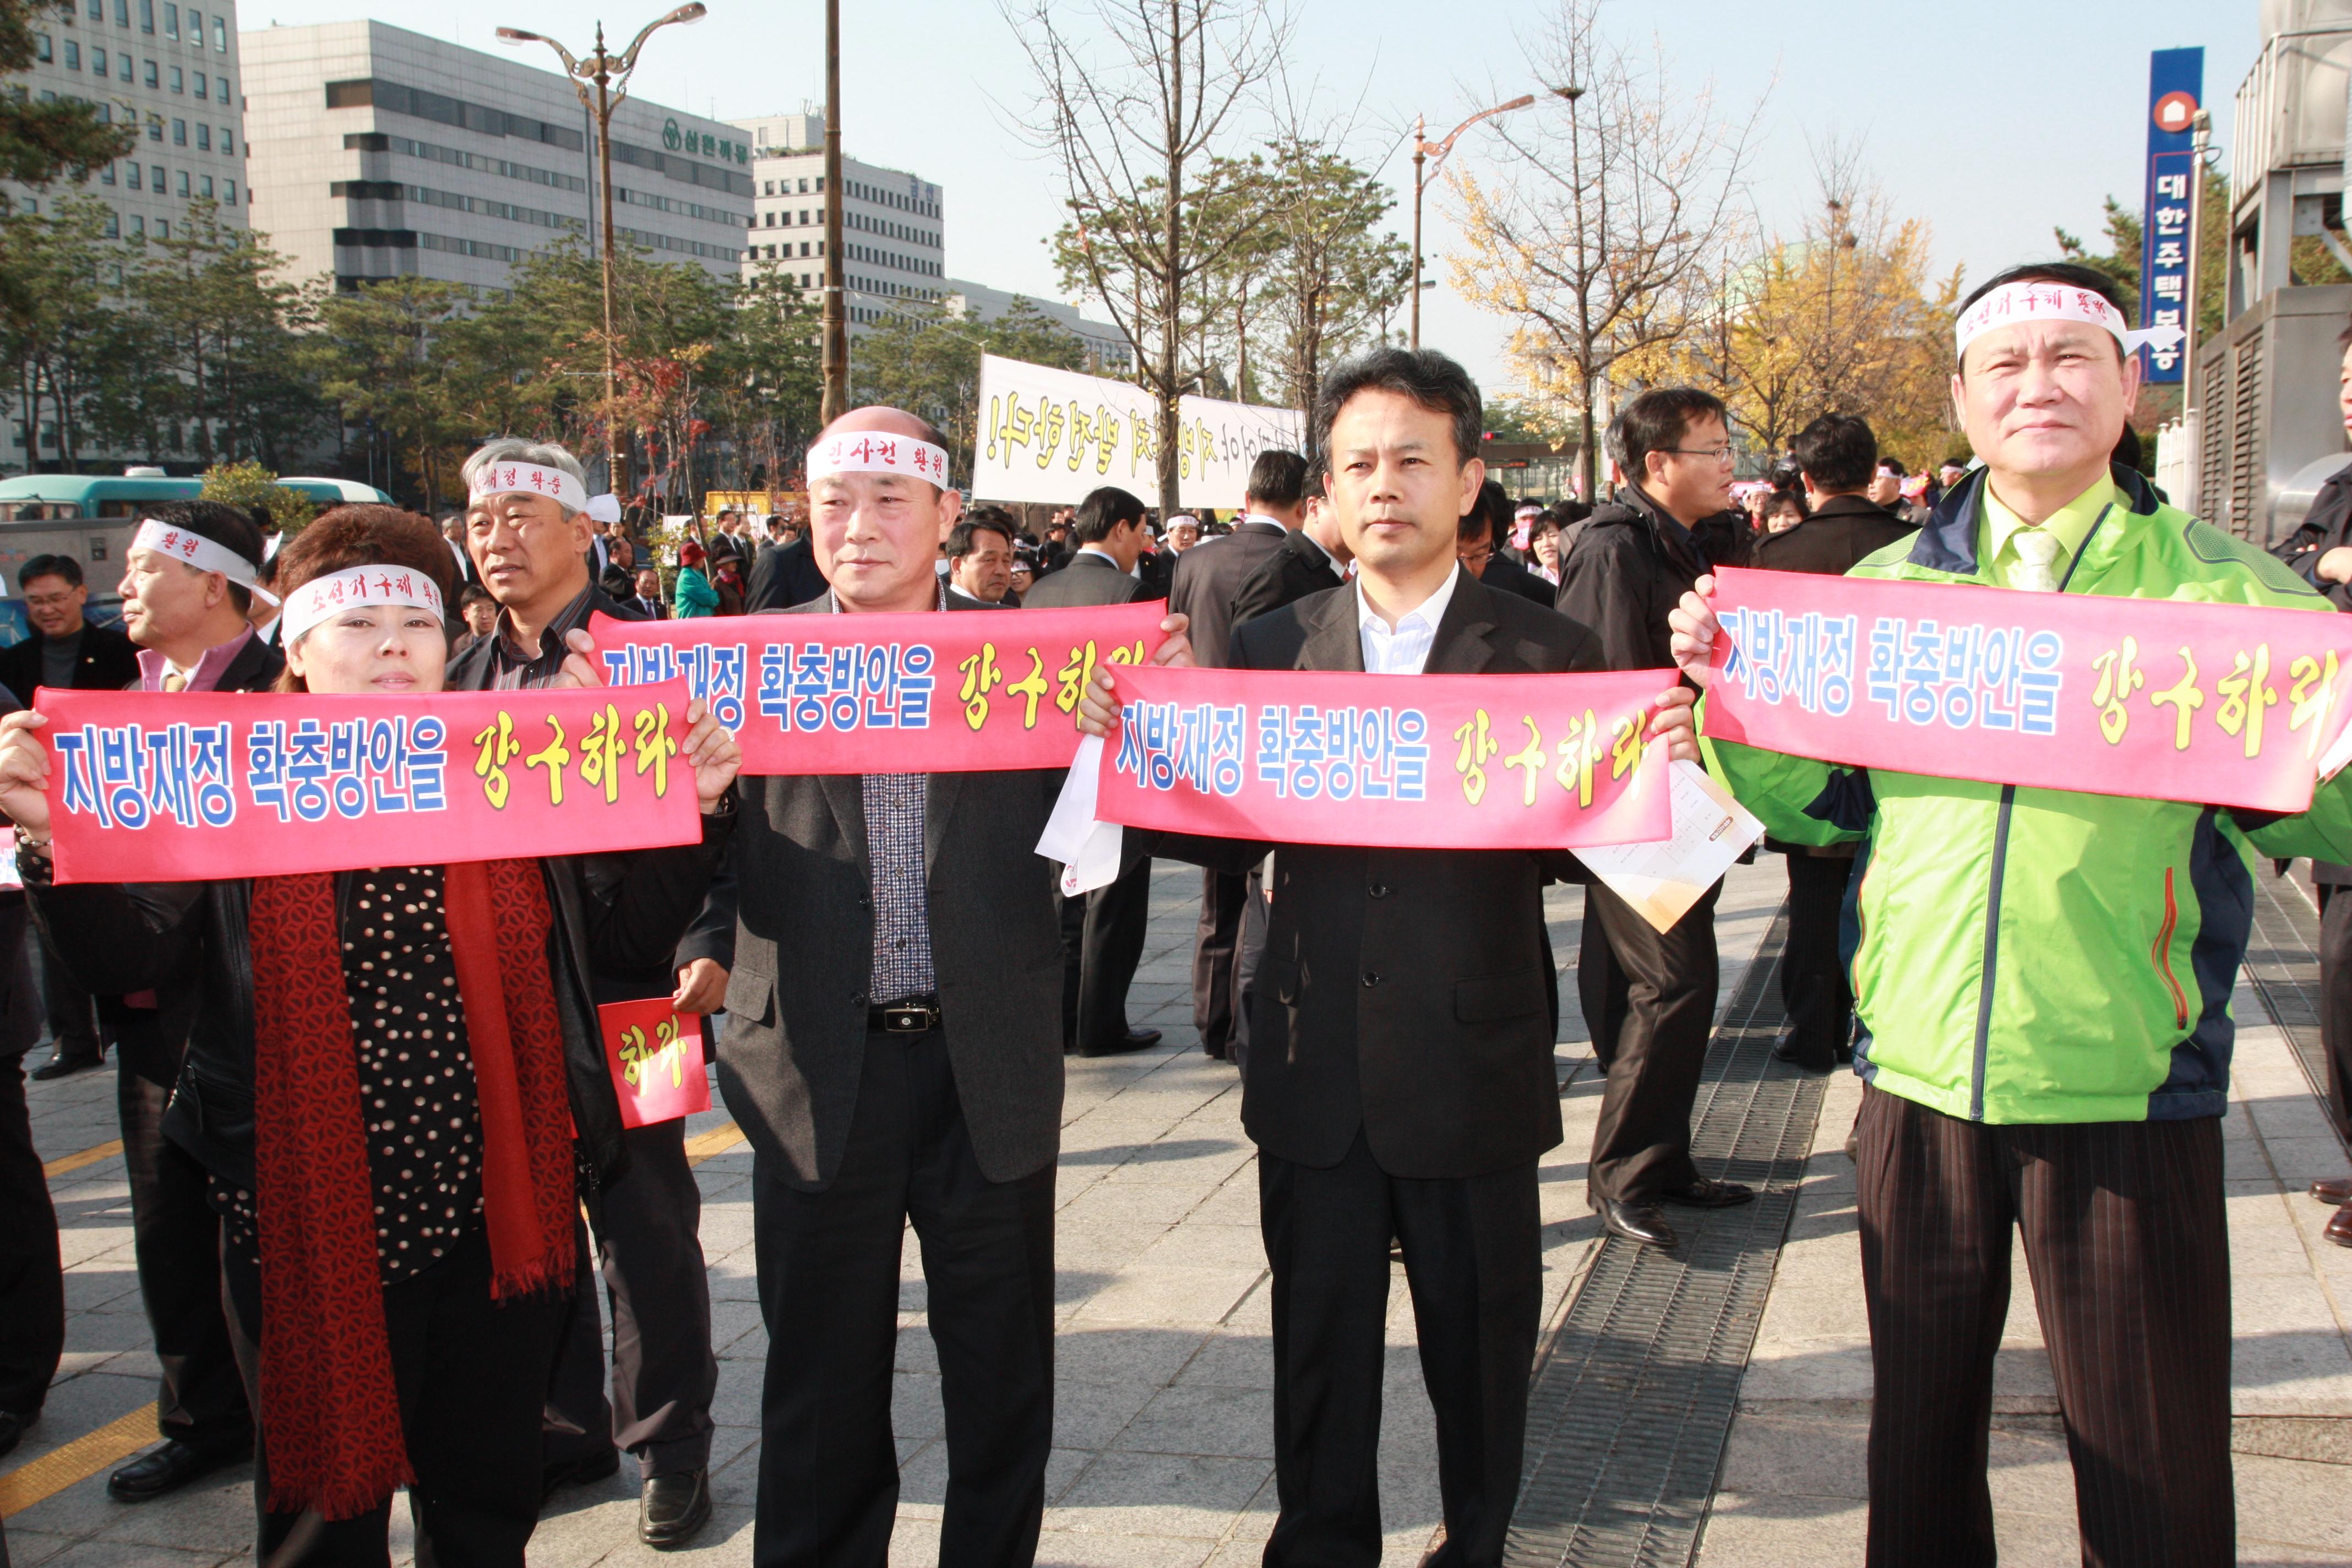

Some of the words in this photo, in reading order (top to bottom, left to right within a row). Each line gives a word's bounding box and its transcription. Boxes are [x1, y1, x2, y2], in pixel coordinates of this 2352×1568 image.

[530, 471, 562, 494] 확충
[829, 438, 896, 465] 인사권
[312, 573, 413, 614] 소선거구제
[758, 643, 935, 733] 확충방안을
[1717, 606, 1858, 716] 지방재정
[1867, 617, 2064, 736] 확충방안을
[2092, 635, 2339, 760] 강구하라
[53, 721, 236, 830] 지방재정
[248, 715, 447, 822] 확충방안을
[473, 702, 677, 810] 강구하라
[1115, 699, 1246, 797] 지방재정
[1257, 705, 1430, 802] 확충방안을
[1453, 707, 1649, 808] 강구하라
[618, 1014, 688, 1097] 하라
